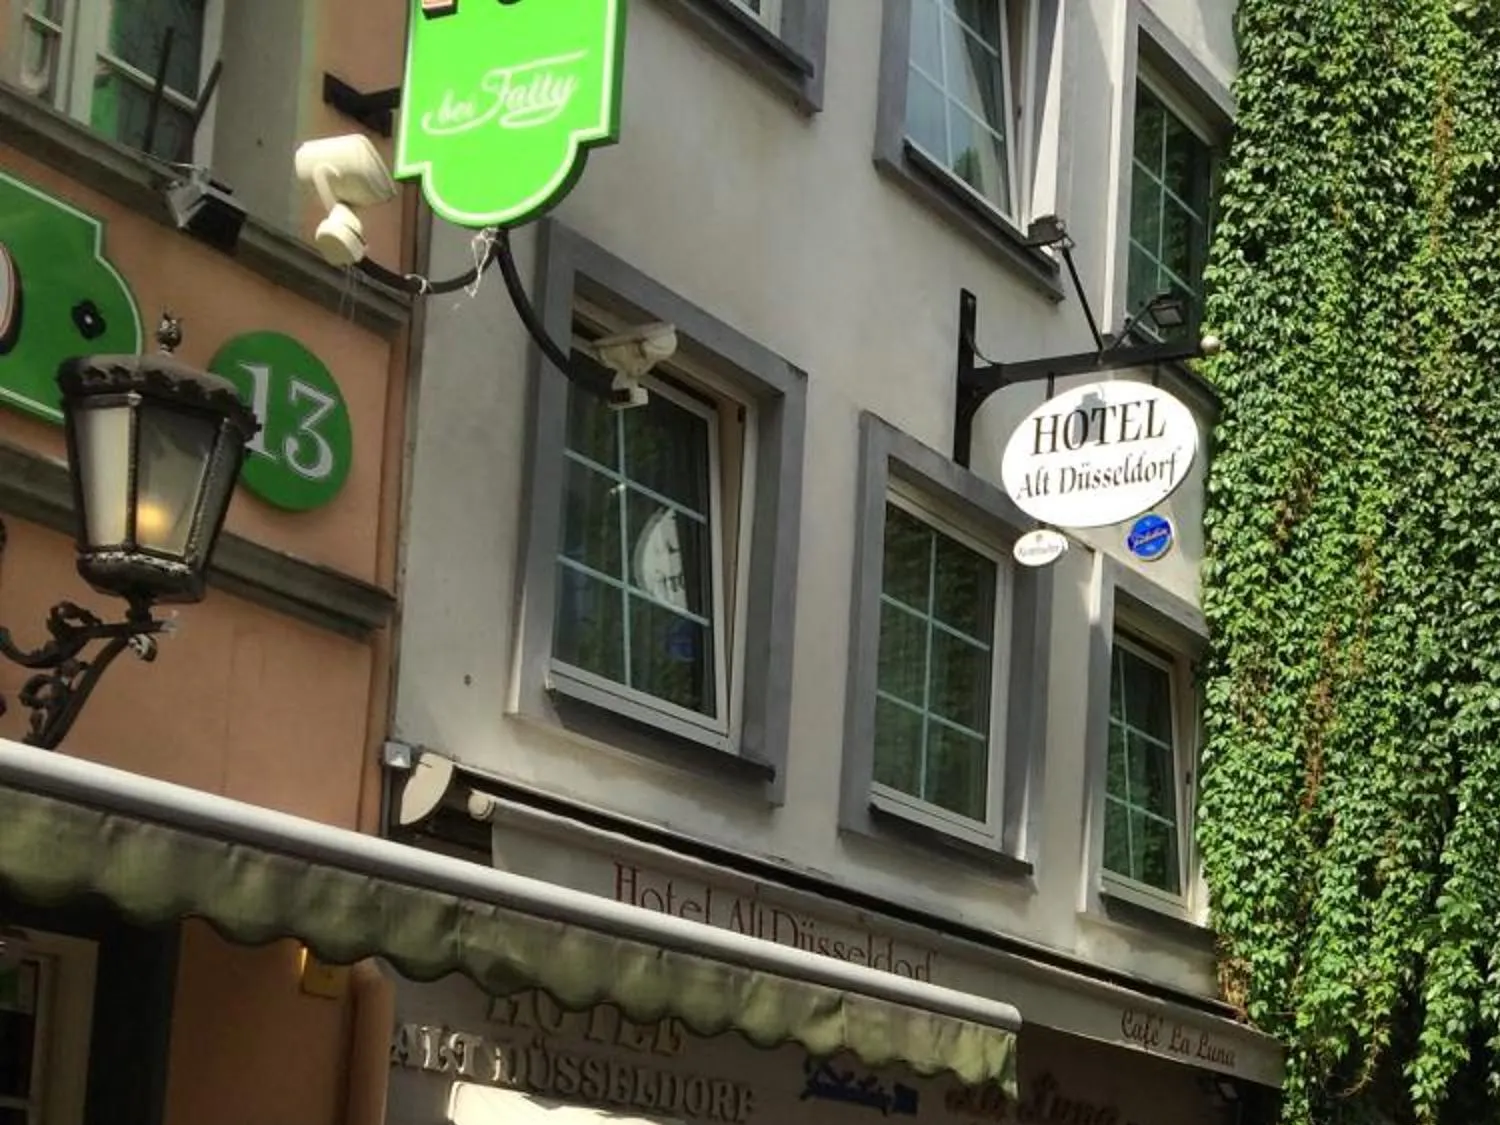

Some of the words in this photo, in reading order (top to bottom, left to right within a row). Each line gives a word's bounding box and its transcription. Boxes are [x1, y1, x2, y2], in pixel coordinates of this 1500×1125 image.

[238, 361, 335, 479] 13
[1028, 398, 1167, 456] HOTEL
[1017, 465, 1051, 500] Alt
[1060, 446, 1182, 495] Düsseldorf
[614, 861, 712, 925] Hotel
[390, 1022, 484, 1077] ALT
[1168, 1023, 1190, 1055] La
[1196, 1031, 1236, 1066] Luna
